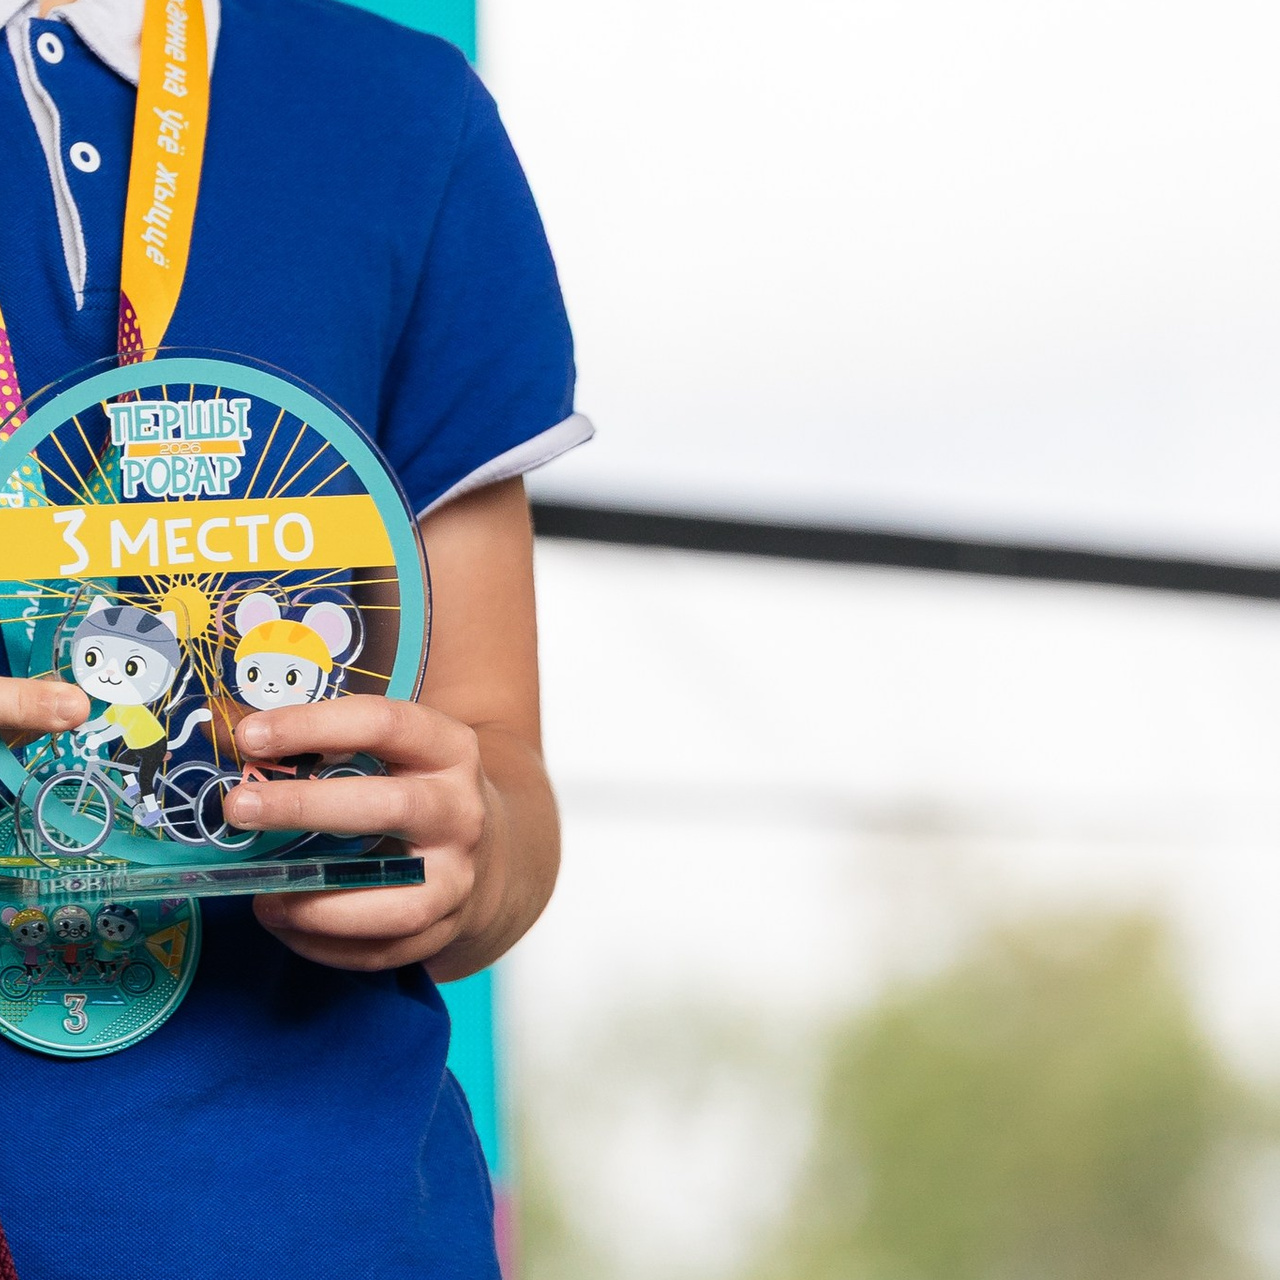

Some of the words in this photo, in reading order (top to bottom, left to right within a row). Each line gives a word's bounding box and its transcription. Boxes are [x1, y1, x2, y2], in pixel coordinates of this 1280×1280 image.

[162, 62, 189, 98] на
[140, 161, 180, 270] жыццё
[108, 400, 251, 443] ПЕРШЫ
[159, 442, 202, 455] 2026
[122, 456, 239, 497] РОВАР
[53, 509, 90, 576] 3
[110, 512, 315, 568] МЕСТО
[63, 992, 89, 1034] 3
